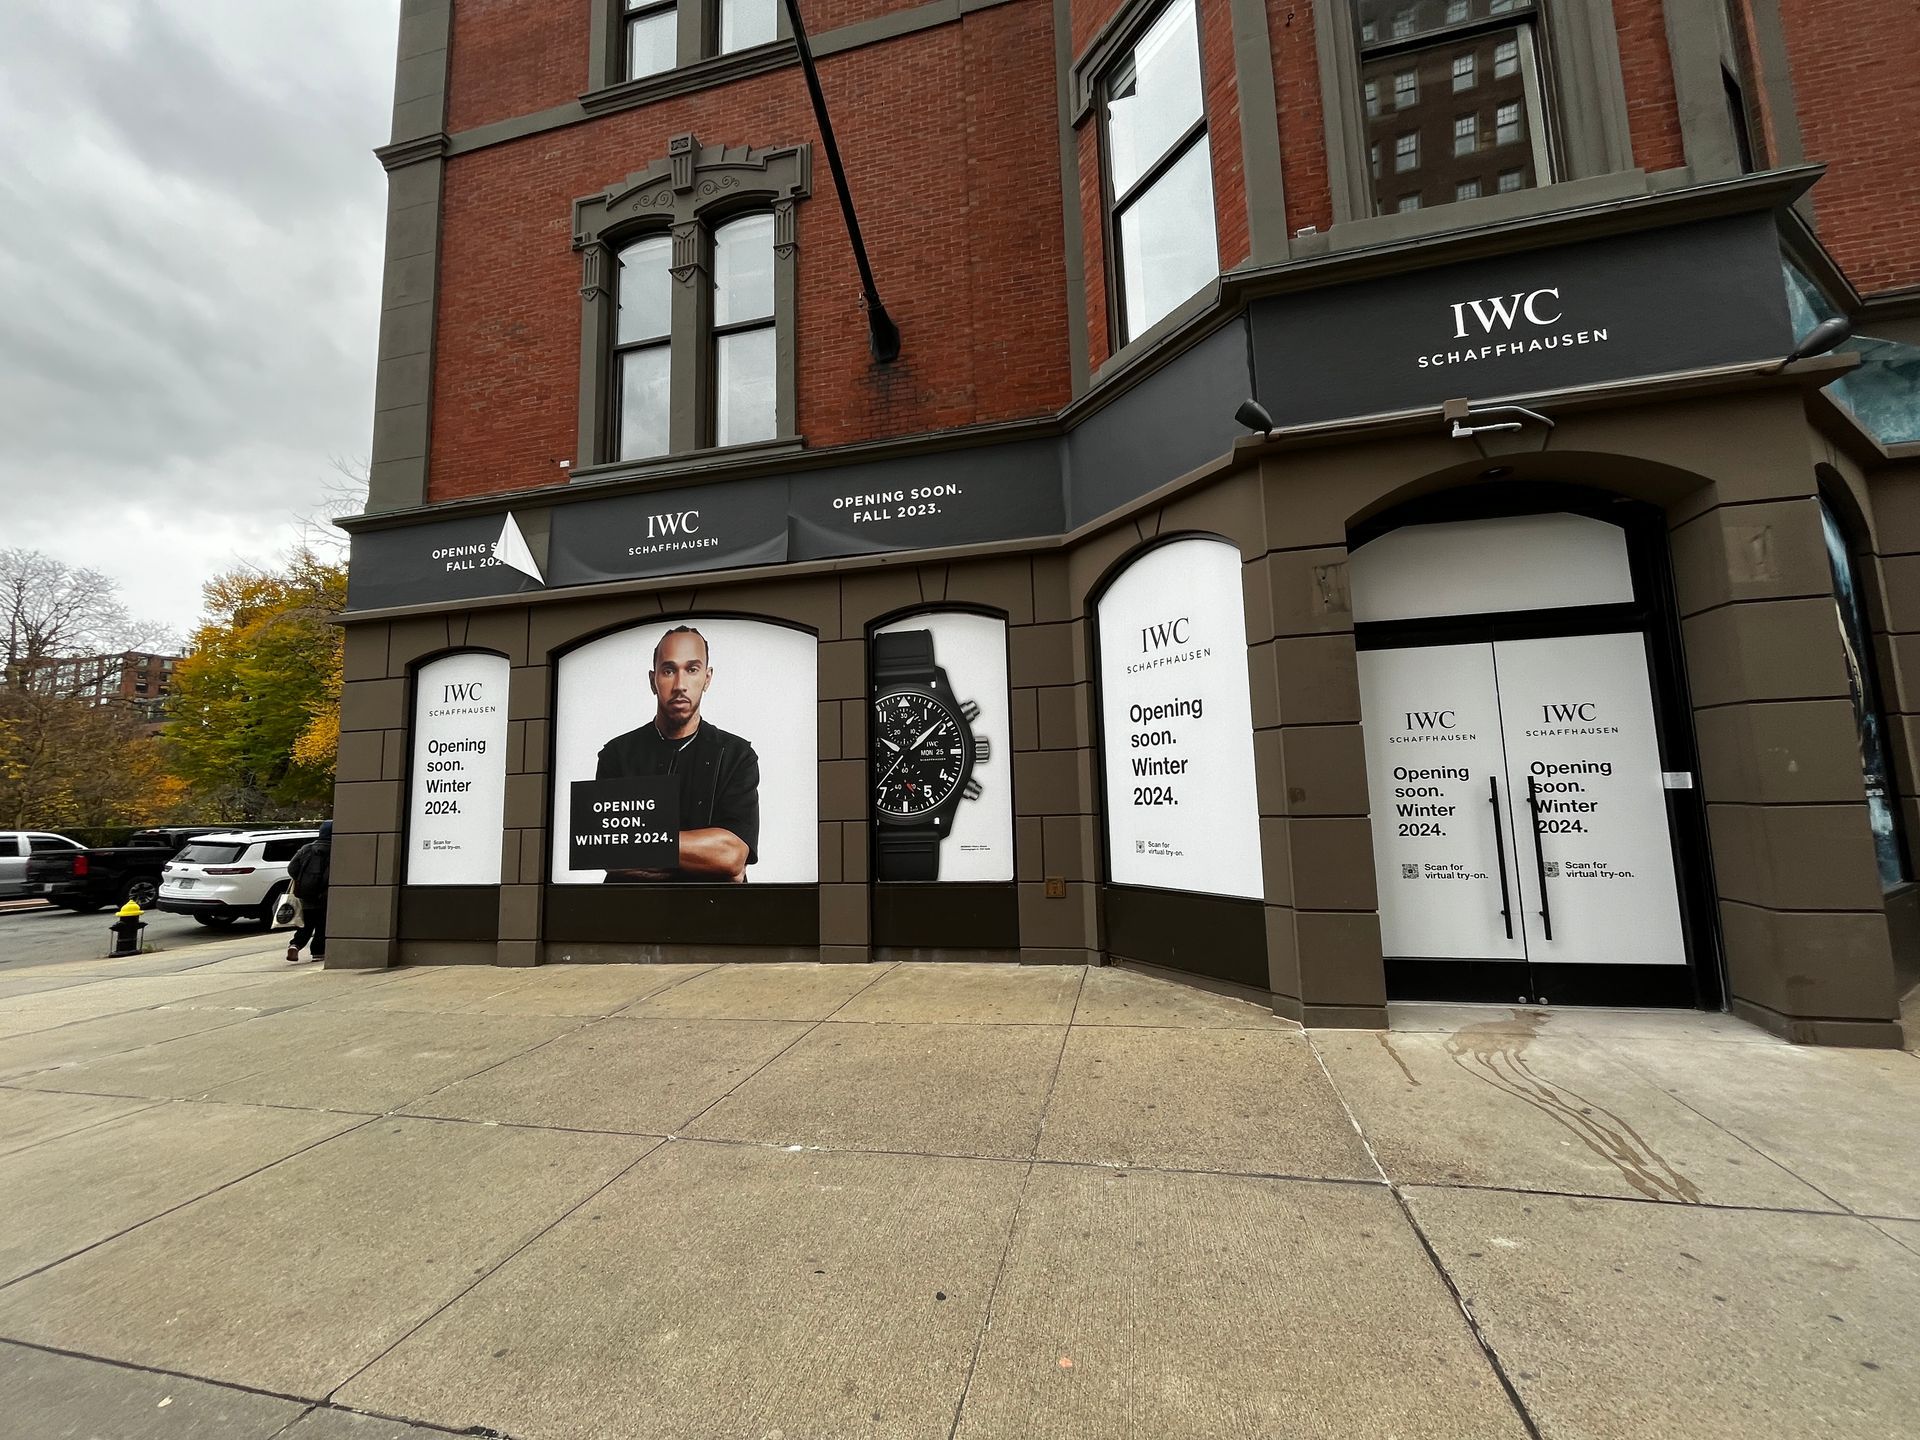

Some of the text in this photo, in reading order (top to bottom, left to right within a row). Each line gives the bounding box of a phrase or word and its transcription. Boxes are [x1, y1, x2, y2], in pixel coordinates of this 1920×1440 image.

[1450, 287, 1562, 339] IWC
[1418, 328, 1608, 368] SCHAFFHAUSEN
[832, 483, 963, 510] OPENING SOON.
[852, 502, 942, 524] FALL 2023.
[646, 510, 700, 539] IWC
[432, 544, 486, 560] OPENING
[628, 537, 719, 556] SCHAFFHAUSEN
[446, 557, 506, 572] FALL 202
[1140, 617, 1190, 653] IWC
[1126, 648, 1211, 674] SCHAFFHAUSEN
[443, 682, 483, 703] IWC
[429, 706, 496, 717] SCHAFFHAUSEN
[1129, 697, 1203, 725] Opening
[1542, 703, 1597, 723] IWC
[1405, 710, 1456, 731] IWC
[1130, 730, 1177, 748] soon.
[1389, 733, 1477, 743] SCHAFFHAUSEN
[1525, 727, 1619, 737] SCHAFFHAUSEN
[428, 738, 486, 756] Opening
[426, 760, 464, 772] soon.
[1131, 757, 1188, 776] Winter
[1530, 760, 1612, 777] Opening
[939, 768, 948, 780] 4
[1393, 766, 1470, 782] Opening
[426, 779, 471, 793] Winter
[880, 787, 887, 799] 7
[923, 785, 933, 797] 5
[1395, 786, 1445, 798] soon.
[1533, 781, 1586, 794] soon.
[1133, 786, 1178, 805] 2024.
[424, 800, 461, 815] 2024.
[593, 800, 656, 812] OPENING
[1396, 803, 1456, 817] Winter
[1537, 800, 1598, 814] Winter
[602, 817, 646, 828] SOON.
[1398, 823, 1447, 837] 2024.
[1538, 820, 1588, 834] 2024.
[576, 832, 673, 846] WINTER 2024.
[1425, 872, 1489, 881] virtual try-on.
[1566, 870, 1635, 879] virtual try-on.
